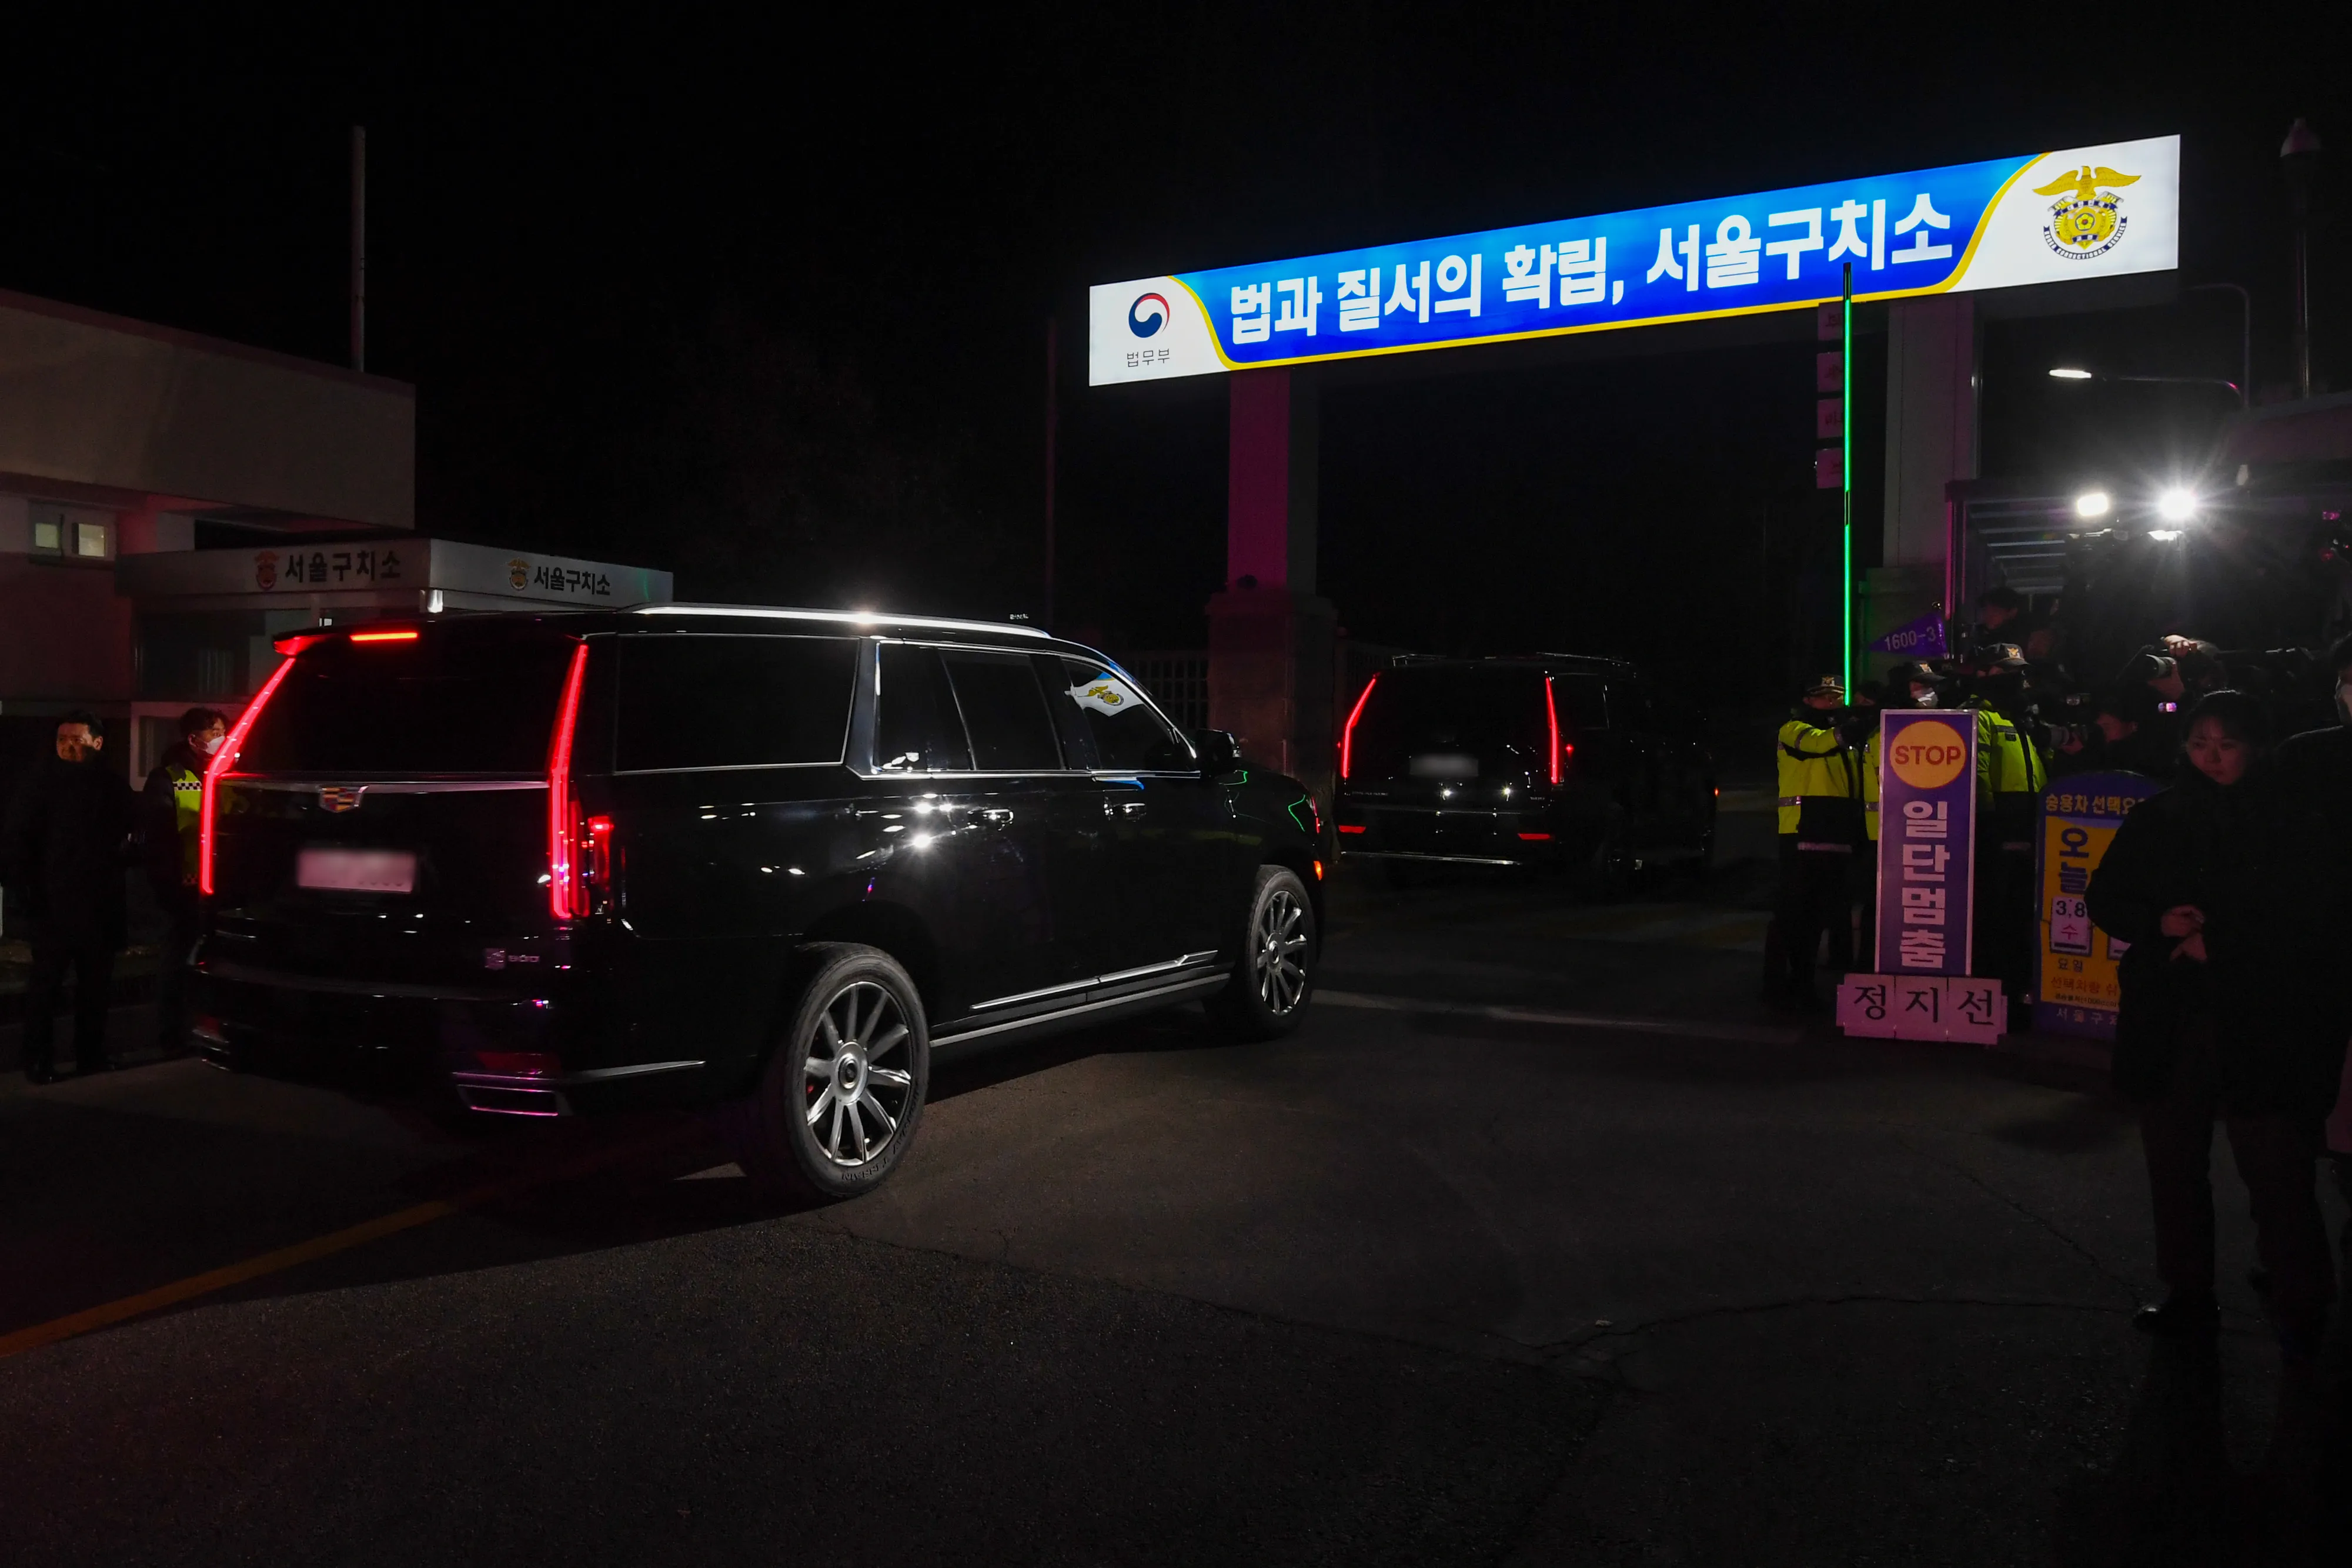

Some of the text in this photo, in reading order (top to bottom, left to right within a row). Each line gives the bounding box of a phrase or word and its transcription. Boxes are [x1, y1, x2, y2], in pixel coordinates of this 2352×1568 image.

[1231, 193, 1953, 345] 법과 질서의 확립, 서울구치소
[1127, 348, 1170, 367] 법무부
[285, 550, 401, 583] 서울구치소
[534, 566, 610, 596] 서울구치소
[1884, 626, 1937, 651] 1600-3
[1895, 745, 1962, 765] STOP
[2092, 795, 2146, 815] 선택요
[2059, 828, 2089, 894] 오늘
[2056, 900, 2085, 918] 3,8
[2060, 925, 2079, 940] 수
[2058, 958, 2083, 973] 요일
[2051, 976, 2100, 994] 선택차량
[1853, 984, 1994, 1026] 정지선
